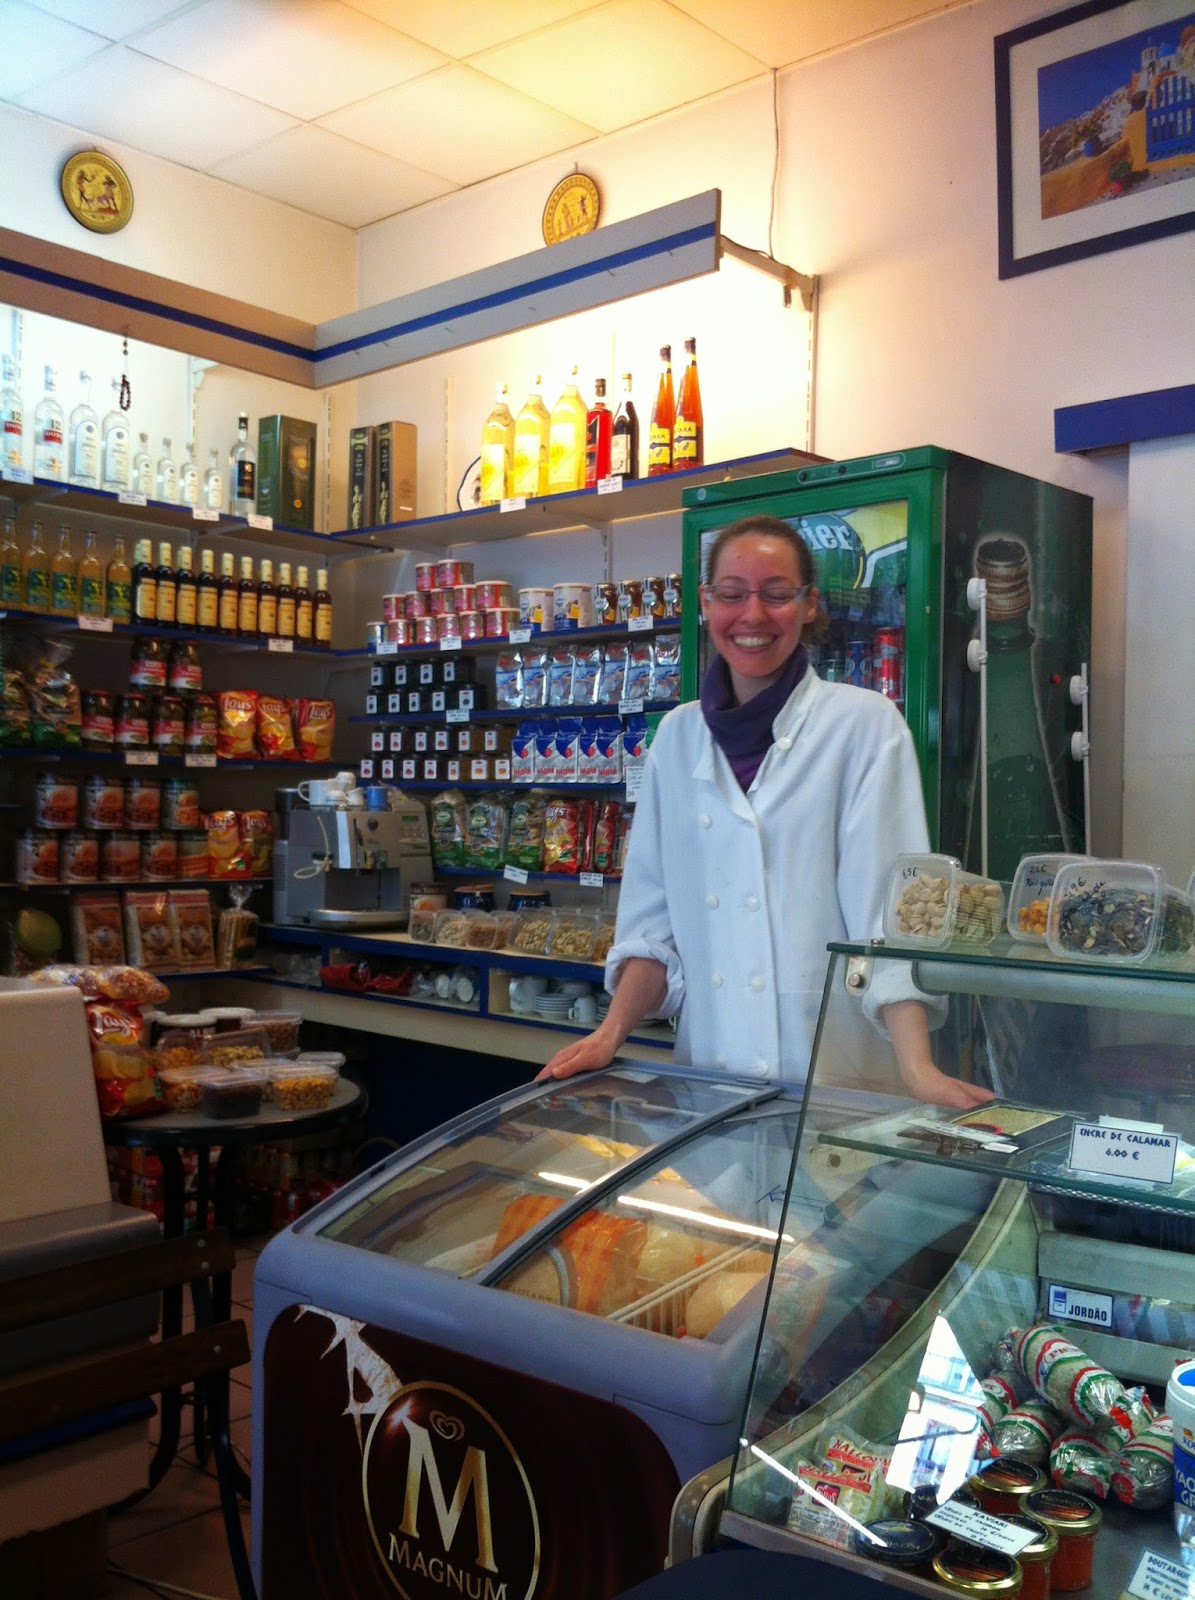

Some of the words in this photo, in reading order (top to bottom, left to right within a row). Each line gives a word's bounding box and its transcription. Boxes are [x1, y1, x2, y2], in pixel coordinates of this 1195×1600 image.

[1080, 1128, 1107, 1139] ENCRE
[1110, 1132, 1122, 1141] DE
[1126, 1134, 1171, 1148] CALAMAR
[1105, 1148, 1128, 1158] 6.00
[1132, 1151, 1140, 1160] €
[973, 1511, 1008, 1529] KAVIARI
[389, 1532, 508, 1600] MAGNUM
